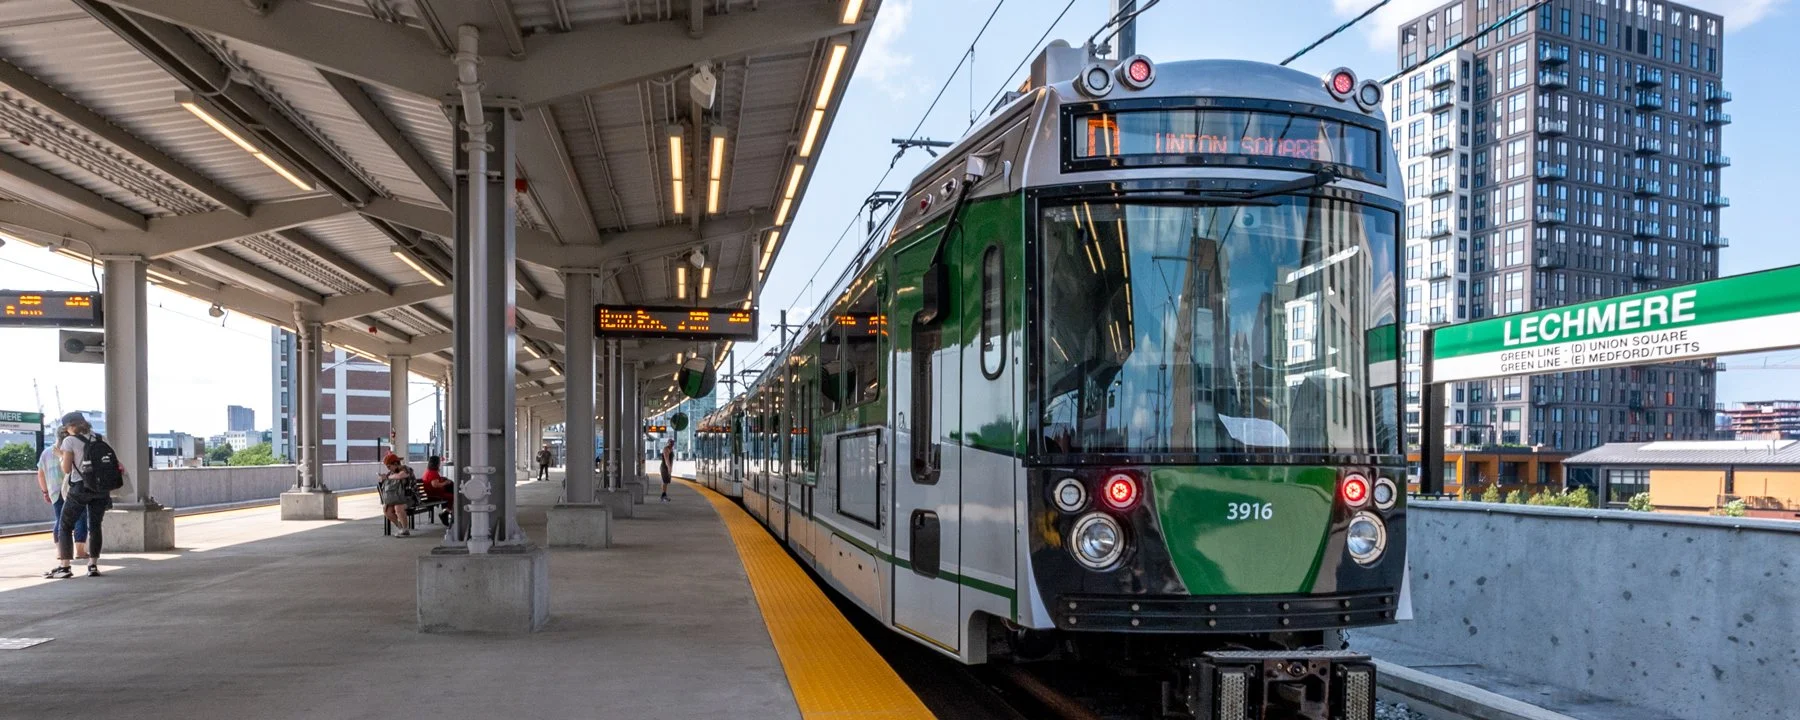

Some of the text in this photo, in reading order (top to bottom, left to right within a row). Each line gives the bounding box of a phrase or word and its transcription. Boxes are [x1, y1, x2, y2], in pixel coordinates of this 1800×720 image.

[1503, 289, 1697, 347] LECHMERE
[1500, 350, 1534, 362] GREEN
[1537, 346, 1560, 357] LINE
[1571, 343, 1586, 354] (D)
[1589, 338, 1628, 351] UNION
[1632, 330, 1688, 346] SQUARE
[1500, 361, 1534, 373] GREEN
[1537, 357, 1560, 368] LINE
[1571, 354, 1586, 366] (E)
[1589, 341, 1700, 363] MEDFORD/TUFTS
[1226, 502, 1273, 520] 3916
